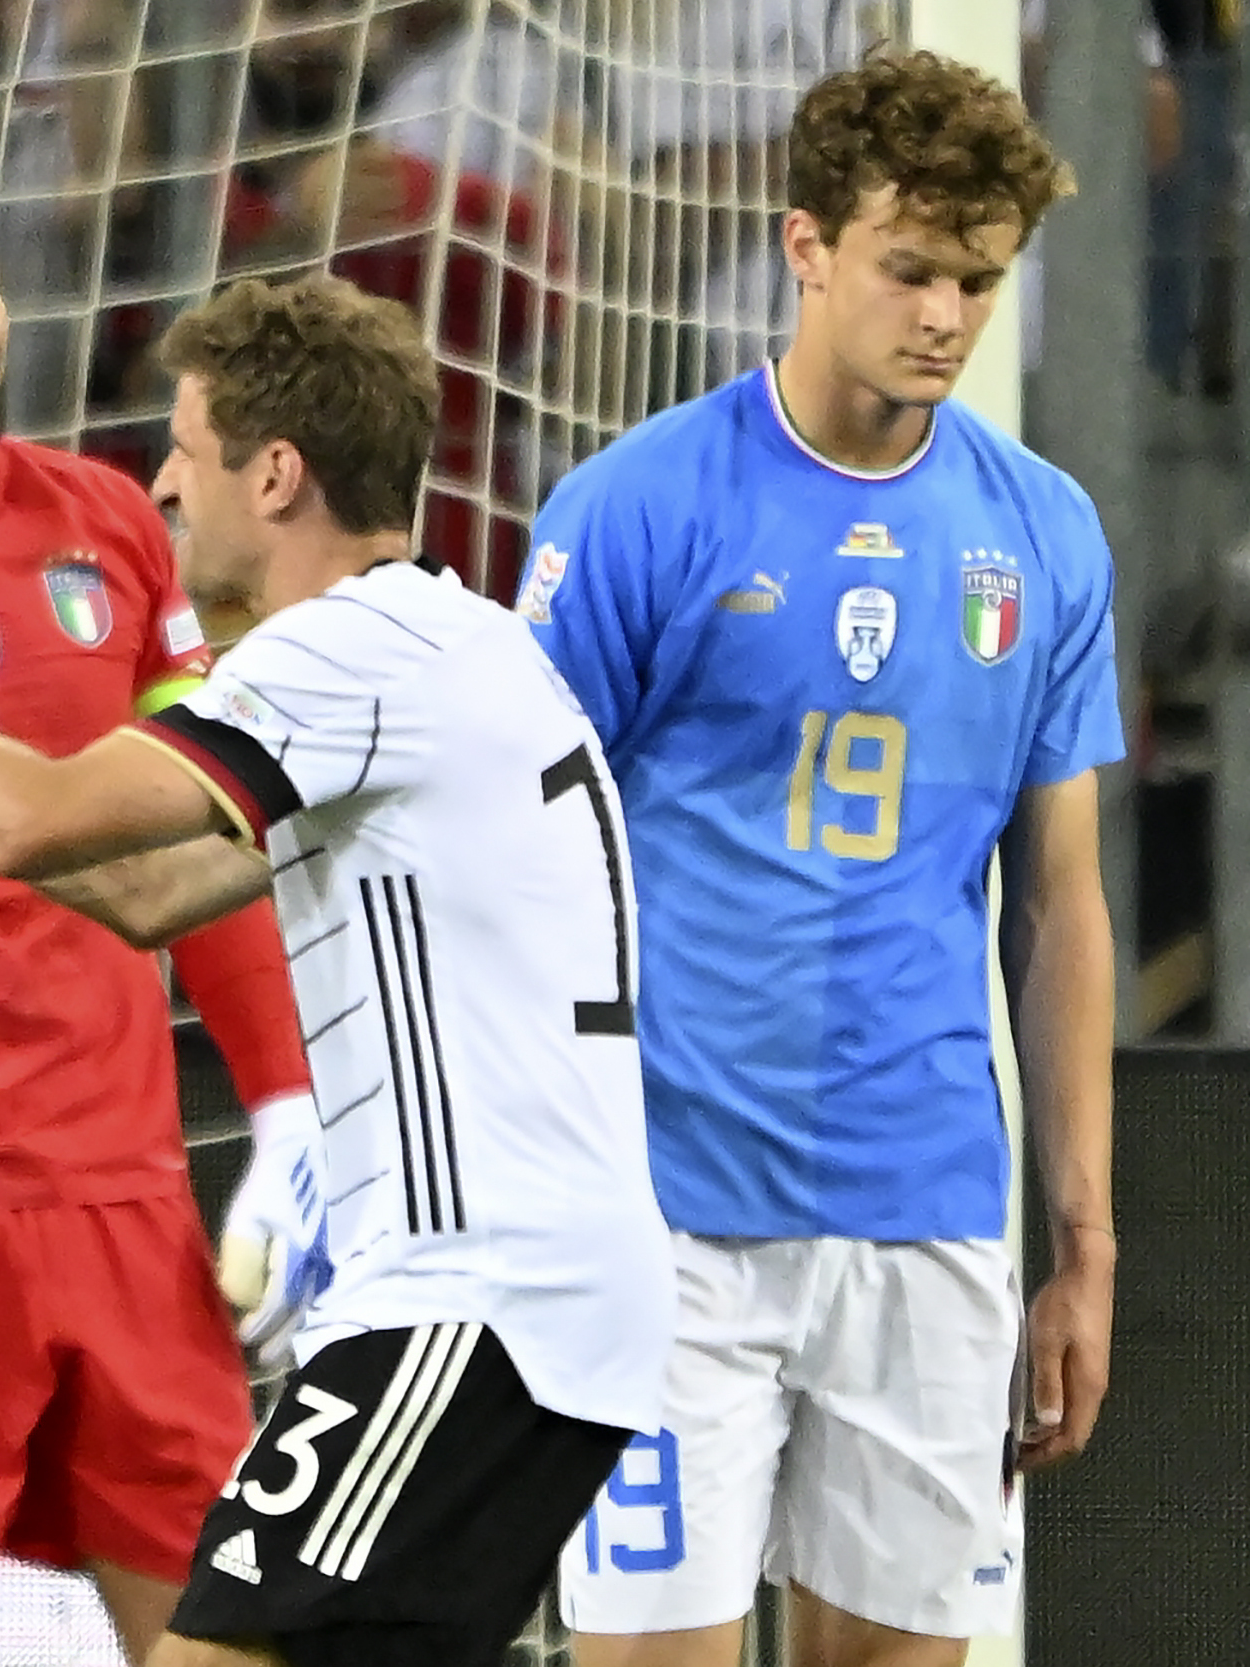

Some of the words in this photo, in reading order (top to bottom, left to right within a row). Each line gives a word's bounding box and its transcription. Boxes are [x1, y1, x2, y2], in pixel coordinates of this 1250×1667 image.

[966, 573, 1018, 591] ITALIA
[787, 710, 906, 860] 19
[220, 1382, 359, 1516] 3
